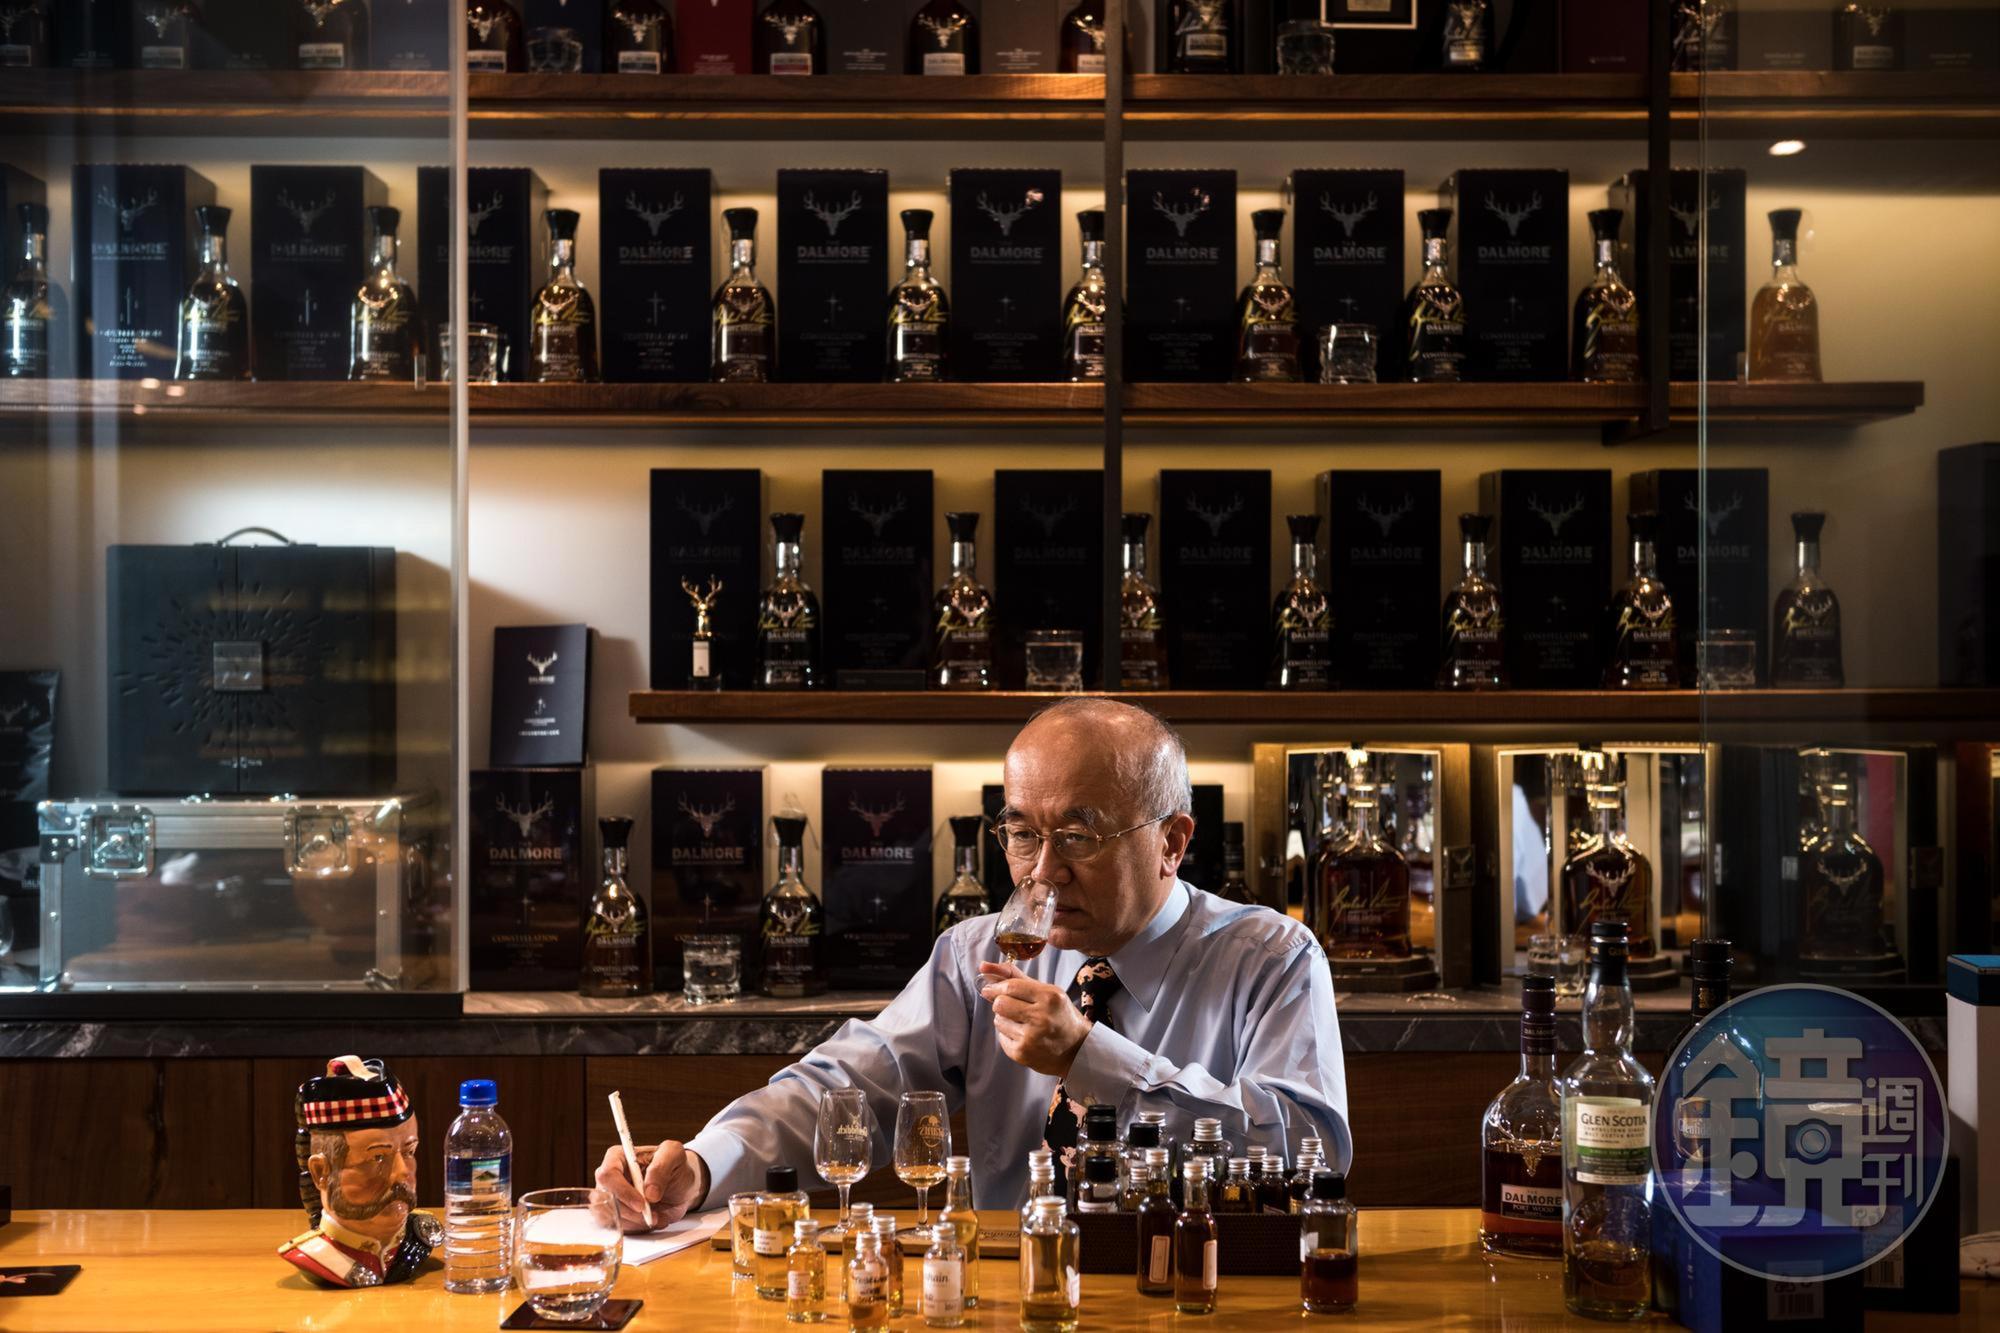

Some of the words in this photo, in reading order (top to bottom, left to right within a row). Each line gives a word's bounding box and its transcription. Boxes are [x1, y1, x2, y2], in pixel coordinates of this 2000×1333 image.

[618, 246, 694, 259] DALMORE
[797, 246, 872, 258] DALMORE
[969, 247, 1043, 259] DALMORE
[1146, 247, 1219, 260] DALMORE
[1313, 246, 1387, 259] DALMORE
[1477, 246, 1551, 258] DALMORE
[1350, 546, 1424, 560] DALMORE
[1520, 546, 1593, 559] DALMORE
[489, 847, 562, 859] DALMORE
[672, 847, 744, 859] DALMORE
[842, 848, 915, 859] DALMORE
[1580, 1112, 1610, 1126] GLEN
[1612, 1115, 1648, 1127] SCOTIA
[1504, 1191, 1562, 1205] DALMORE
